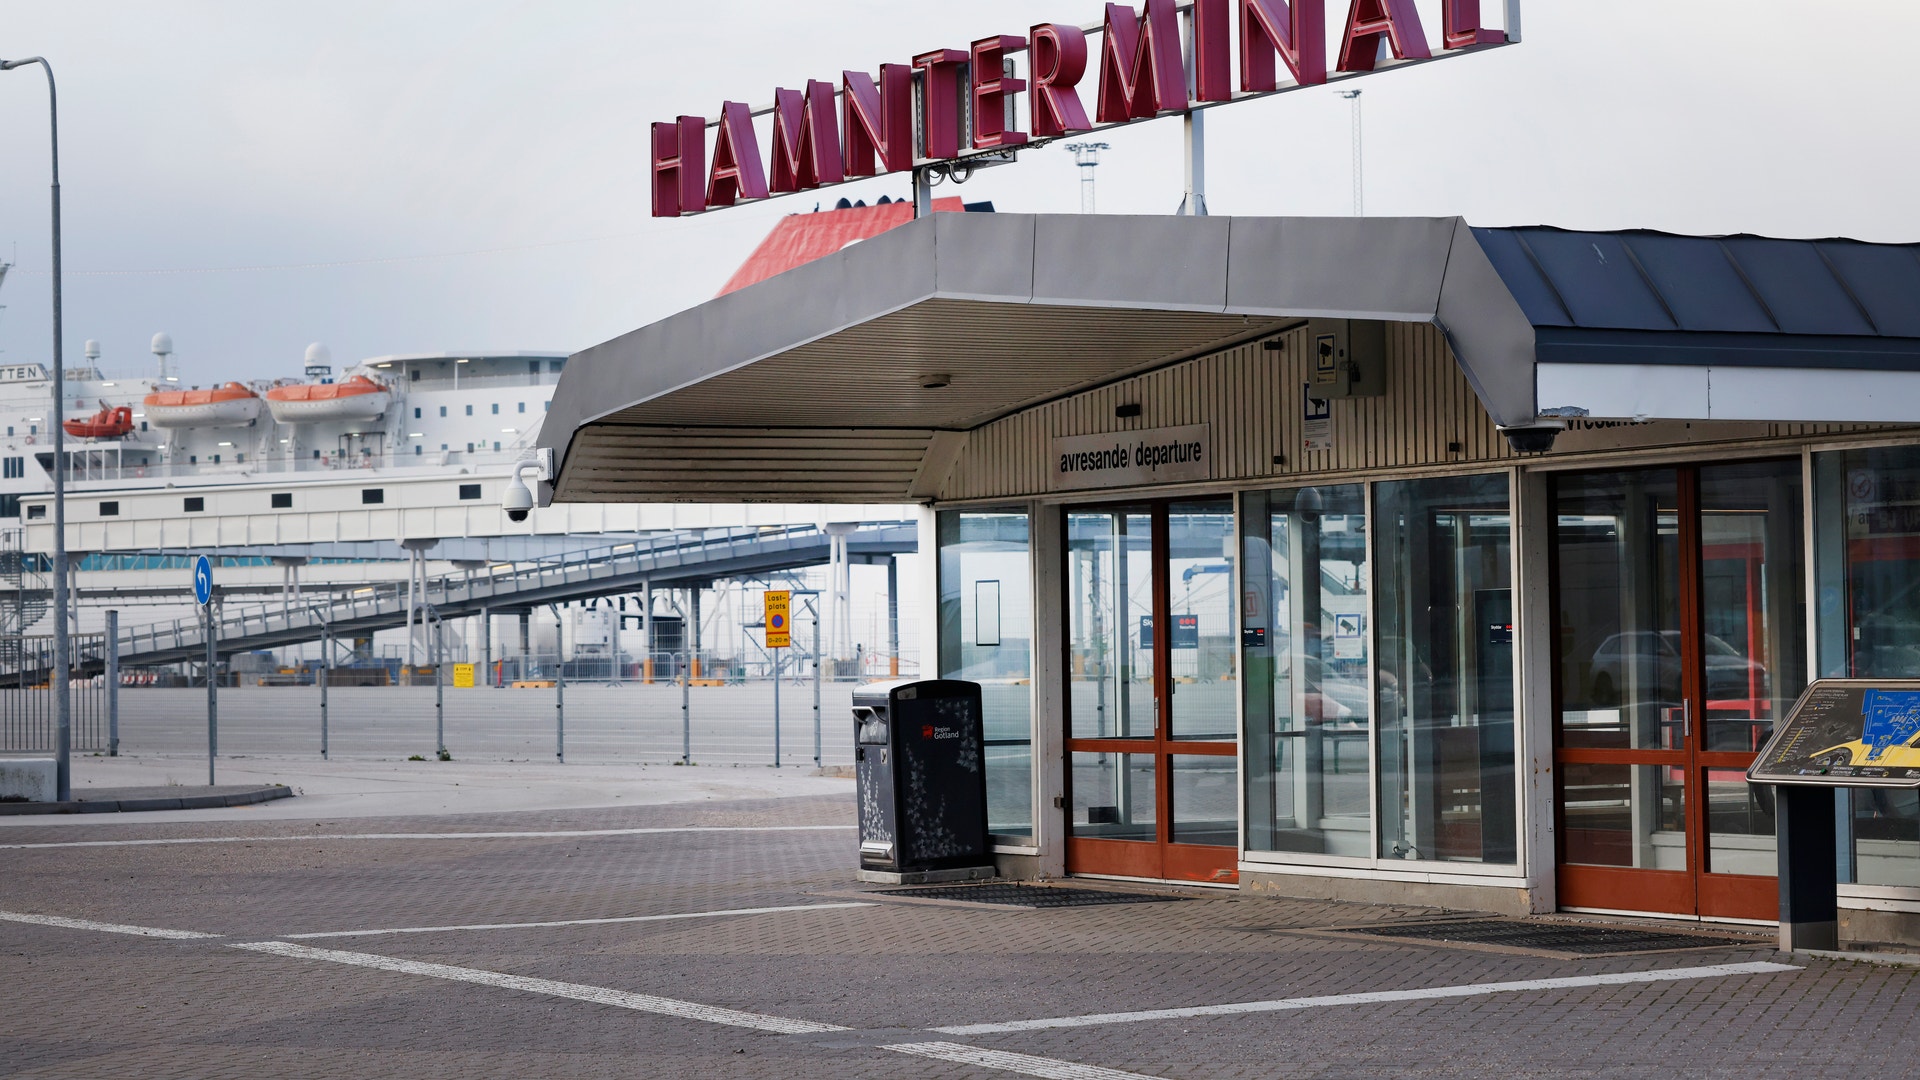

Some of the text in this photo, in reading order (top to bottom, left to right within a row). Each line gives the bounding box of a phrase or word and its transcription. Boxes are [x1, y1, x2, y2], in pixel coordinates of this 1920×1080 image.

[1060, 440, 1201, 473] avresande/ departure
[934, 731, 959, 740] Gotland
